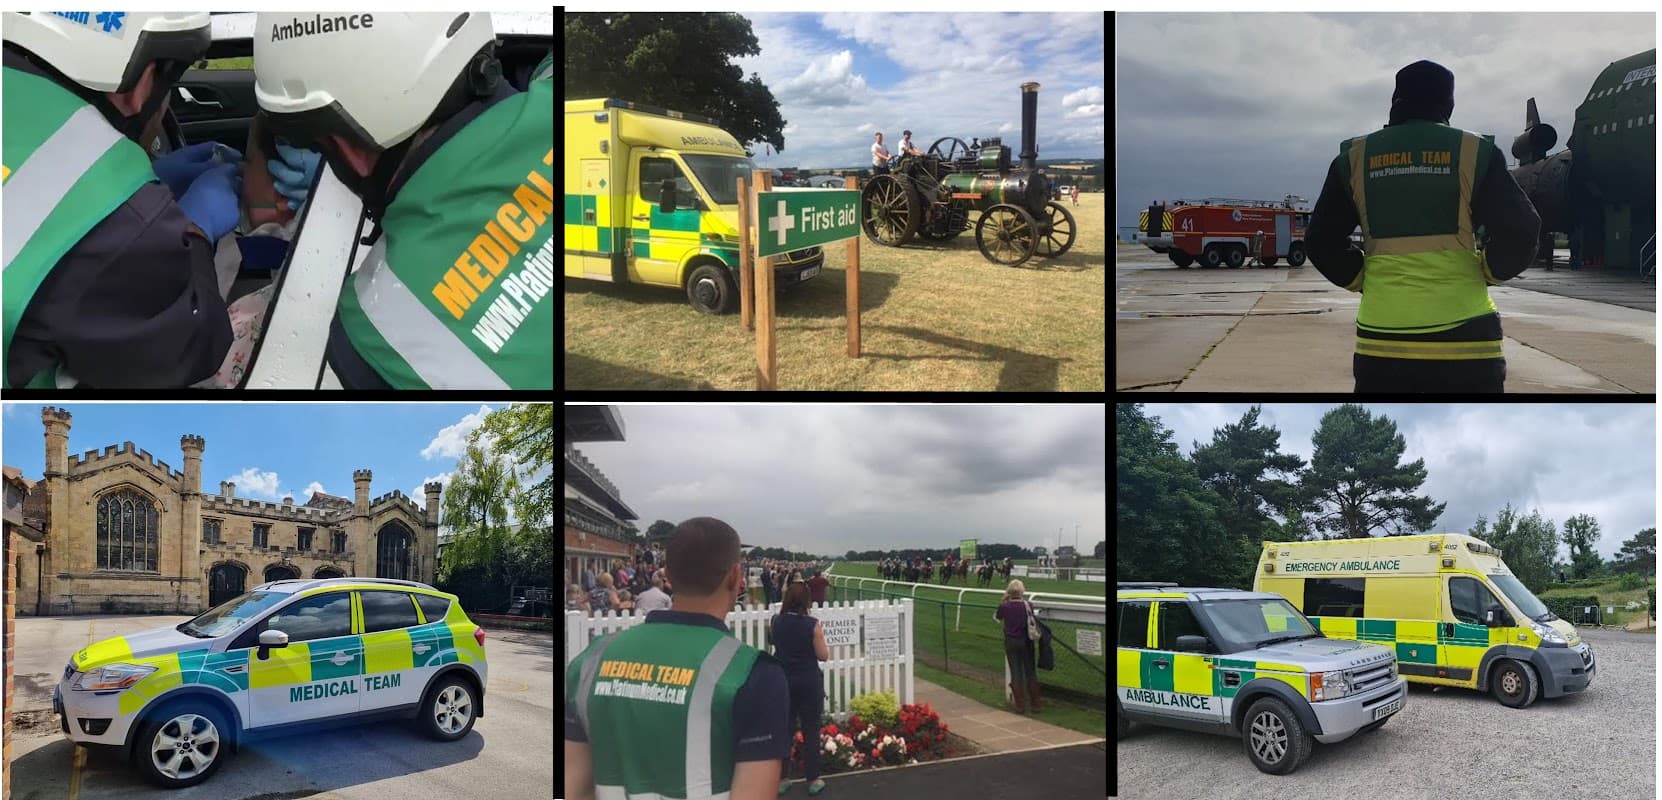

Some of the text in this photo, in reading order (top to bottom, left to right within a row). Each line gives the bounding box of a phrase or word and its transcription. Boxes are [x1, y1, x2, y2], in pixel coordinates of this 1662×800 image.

[271, 13, 374, 42] Ambulance
[1369, 151, 1451, 169] MEDICAL TEAM
[801, 203, 856, 233] First aid
[1182, 217, 1194, 232] 41
[1285, 560, 1400, 572] EMERGENCY AMBULANCE
[826, 635, 850, 644] ONLY
[1350, 657, 1371, 666] LAND
[599, 660, 695, 686] MEDICAL TEAM
[290, 673, 401, 702] MEDICAL TEAM
[1126, 689, 1211, 710] AMBULANCE
